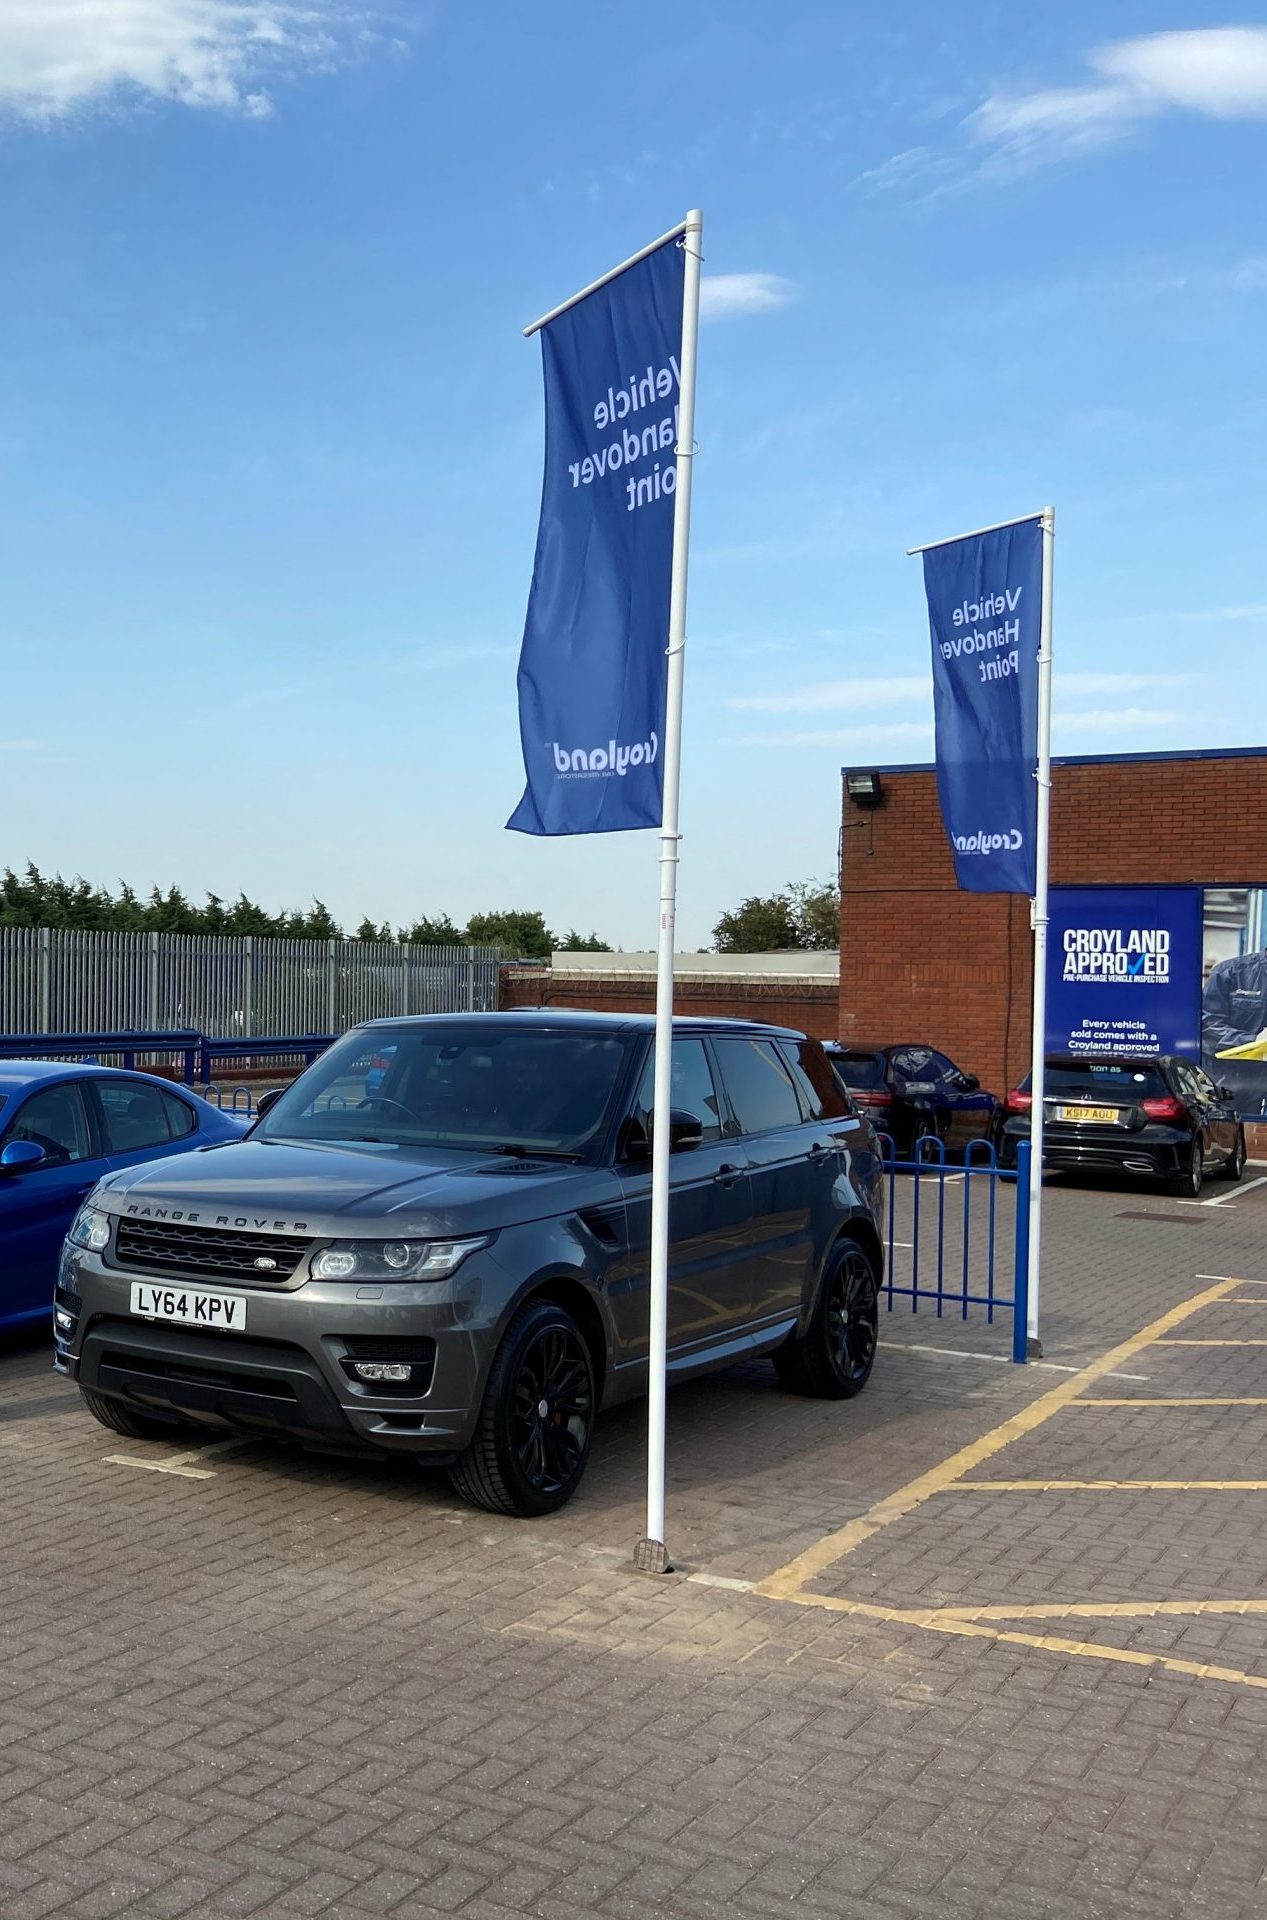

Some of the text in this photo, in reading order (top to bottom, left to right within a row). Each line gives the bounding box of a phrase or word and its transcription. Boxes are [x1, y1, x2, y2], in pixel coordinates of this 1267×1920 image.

[1063, 929, 1169, 953] CROYLAND
[1063, 973, 1169, 983] PRE-PURCHASE VEHICLE INSPECTION
[1082, 1019, 1146, 1030] Every vehicle
[1071, 1030, 1092, 1038] sold
[1093, 1032, 1125, 1040] comes
[1127, 1031, 1148, 1040] with
[1068, 1040, 1160, 1052] Croyland approved
[127, 1204, 308, 1232] RANGE ROVER
[138, 1287, 236, 1324] LY64 KPV
